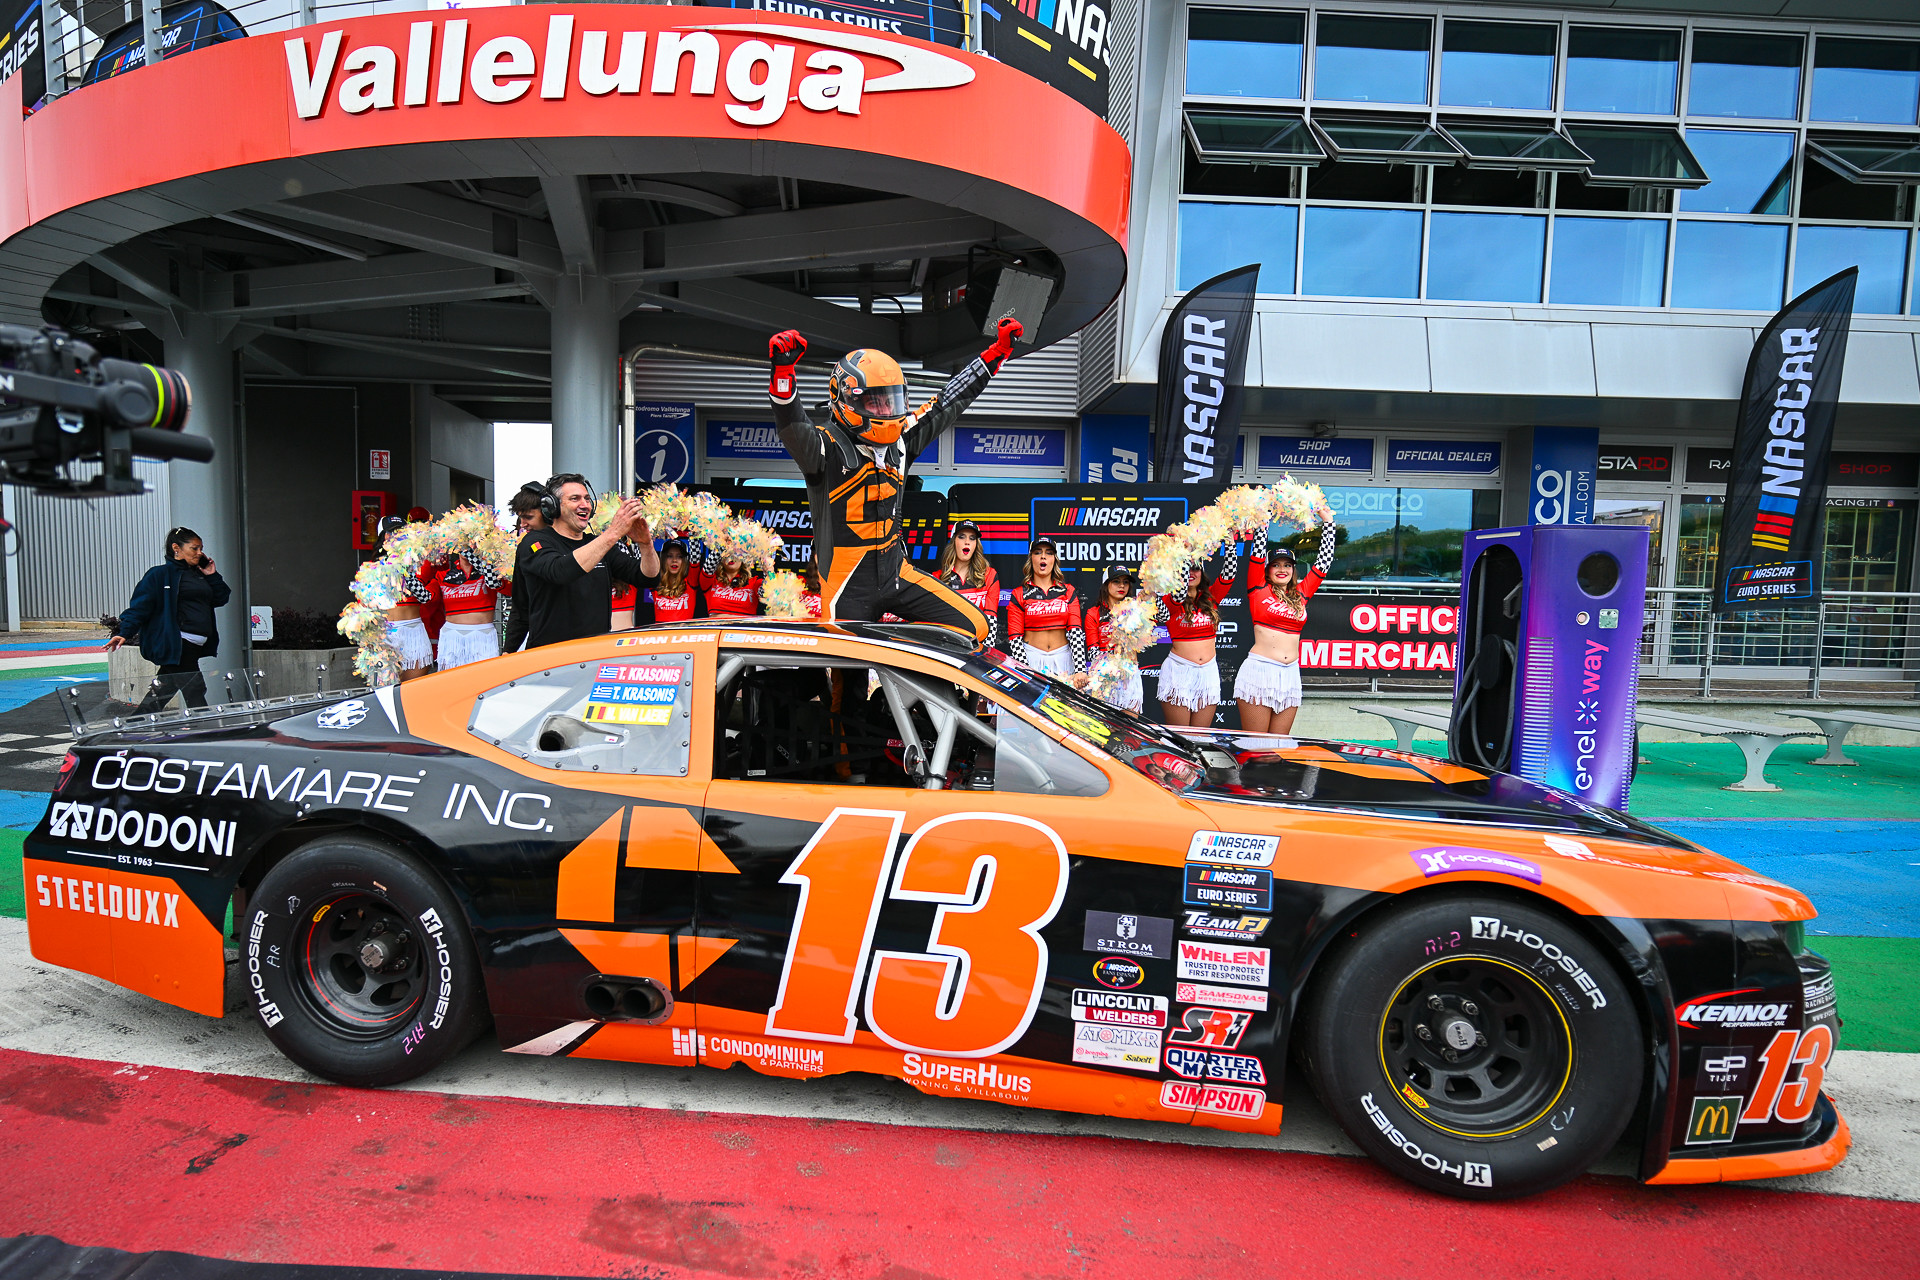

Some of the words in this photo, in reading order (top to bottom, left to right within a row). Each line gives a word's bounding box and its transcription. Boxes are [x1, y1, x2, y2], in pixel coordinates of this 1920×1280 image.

[284, 14, 864, 126] Vallelunga
[1761, 327, 1820, 497] NASCAR
[992, 434, 1045, 450] DANY
[1298, 441, 1331, 451] SHOP
[1280, 455, 1351, 466] VALLELUNGA
[1396, 451, 1445, 462] OFFICIAL
[1448, 451, 1492, 462] DEALER
[1110, 447, 1138, 483] FO
[1839, 464, 1891, 474] SHOP
[1825, 499, 1880, 507] ACING.IT
[1082, 508, 1160, 527] NASCAR
[1058, 543, 1102, 561] EURO
[1753, 566, 1795, 579] NASCAR
[1737, 584, 1760, 597] EURO
[1761, 584, 1796, 595] SERIES
[638, 635, 668, 645] VAN
[671, 634, 716, 643] LAERE
[745, 634, 818, 646] KRASONIS
[619, 667, 627, 680] T.
[628, 667, 681, 682] KRASONIS
[1582, 639, 1609, 694] way
[612, 687, 621, 700] T.
[622, 687, 675, 702] KRASONIS
[619, 707, 639, 721] VAN
[639, 708, 670, 722] LAERE
[1574, 728, 1597, 790] enel
[92, 755, 415, 813] COSTAMARE
[442, 783, 554, 832] INC.
[95, 808, 237, 857] DODONI
[1218, 836, 1266, 850] NASCAR
[118, 855, 131, 865] EST.
[133, 856, 152, 867] 1963
[1201, 849, 1232, 859] RACE
[1237, 851, 1261, 861] CAR
[1449, 855, 1535, 874] HOOSIER
[1213, 871, 1257, 885] NASCAR
[36, 874, 179, 928] STEELDUXX
[1197, 889, 1222, 901] EURO
[1225, 890, 1258, 904] SERIES
[764, 807, 1070, 1059] 13
[1189, 928, 1256, 940] ORGANIZATION
[1097, 939, 1153, 952] STROM
[248, 910, 269, 1007] HOOSIER
[1180, 943, 1266, 966] WHELEN
[1109, 963, 1139, 974] NASCAR
[1184, 961, 1217, 971] TRUSTED
[1219, 964, 1229, 972] TO
[1230, 965, 1265, 975] PROTECT
[1189, 969, 1208, 978] FIRST
[1211, 971, 1260, 982] RESPONDERS
[1501, 925, 1607, 1010] HOOSIER
[429, 931, 452, 1030] HOOSIER
[1077, 992, 1150, 1011] LINCOLN
[1199, 989, 1266, 1003] SAMSONAS
[1093, 1010, 1157, 1026] WELDERS
[1680, 1004, 1788, 1022] KENNOL
[711, 1037, 824, 1065] CONDOMINIUM
[760, 1058, 767, 1066] &
[769, 1060, 824, 1073] PARTNERS
[1167, 1049, 1258, 1070] QUARTER
[1183, 1064, 1261, 1082] MASTER
[1739, 1024, 1833, 1123] 13
[903, 1077, 949, 1090] WONING
[967, 1086, 1030, 1102] VILLABOUW
[1168, 1085, 1256, 1113] SIMPSON
[1361, 1092, 1463, 1179] HOOSIER
